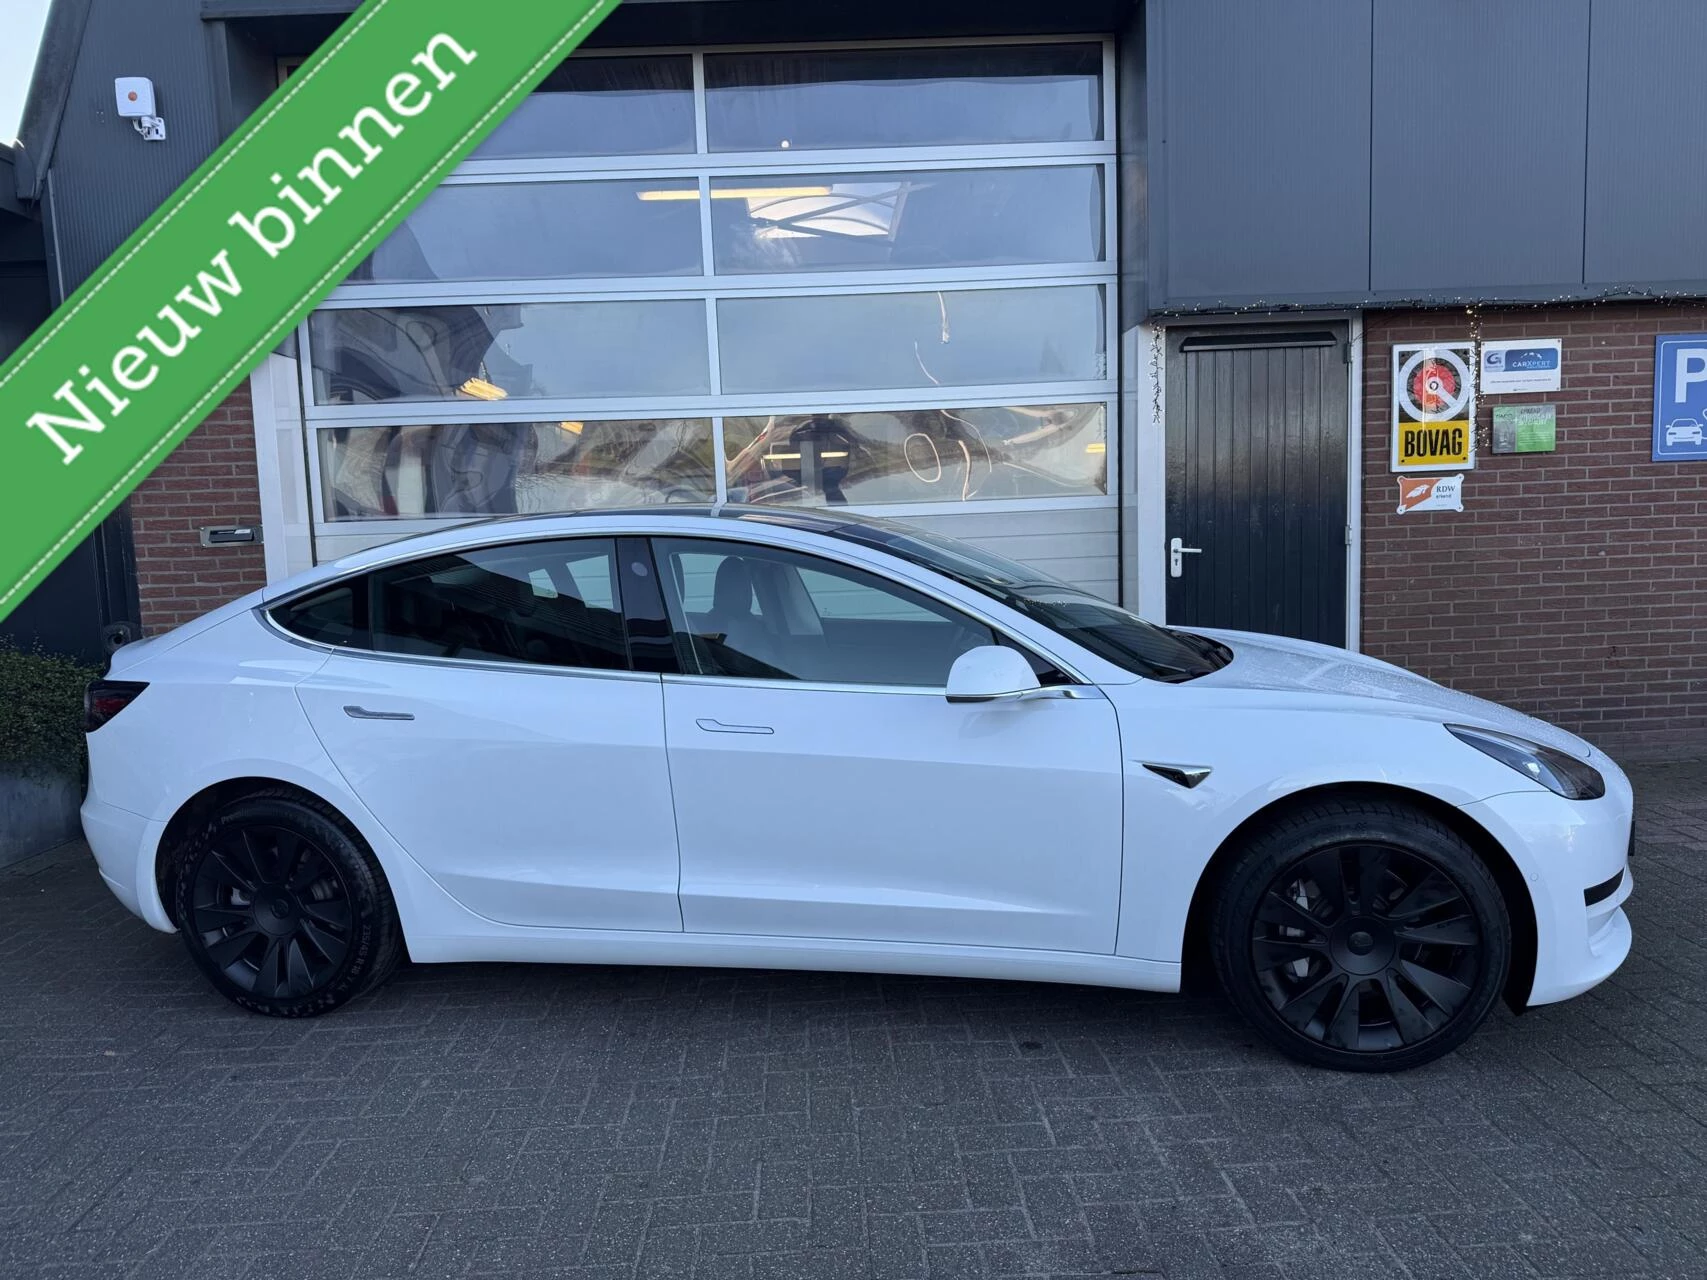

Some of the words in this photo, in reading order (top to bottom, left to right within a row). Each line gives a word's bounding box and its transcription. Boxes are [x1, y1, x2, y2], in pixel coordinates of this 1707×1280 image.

[1675, 348, 1707, 403] P
[1404, 428, 1462, 457] BOVAG
[1436, 485, 1456, 493] RDW
